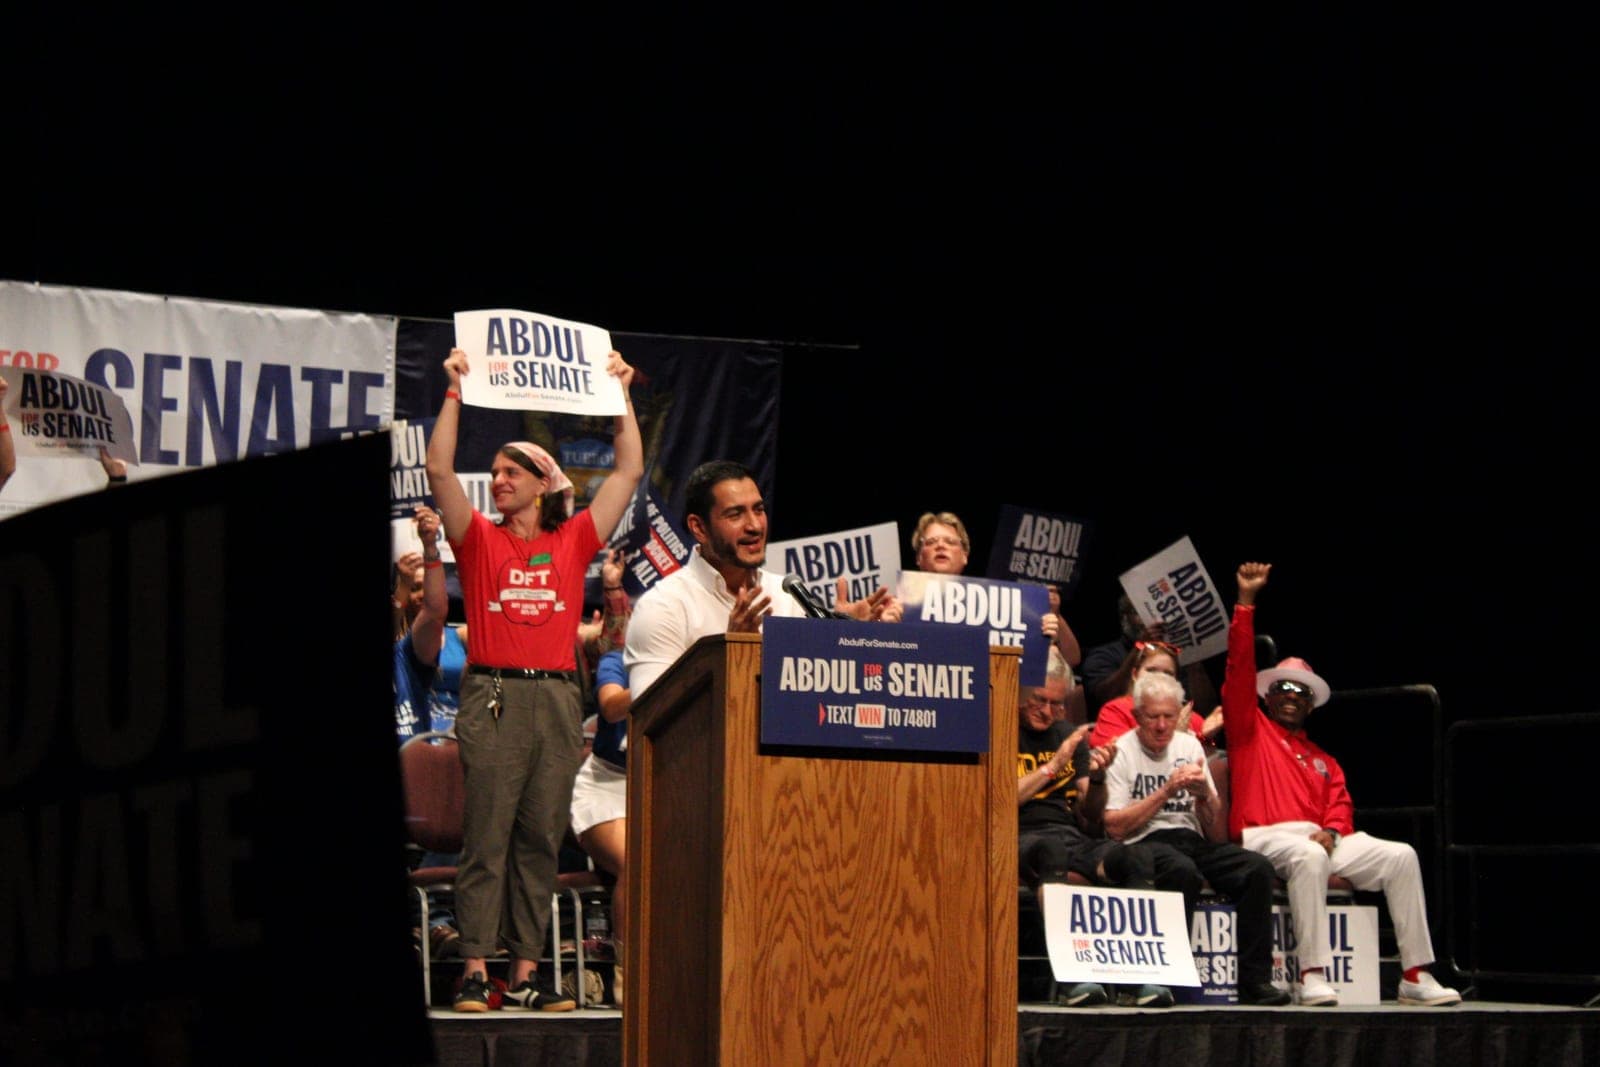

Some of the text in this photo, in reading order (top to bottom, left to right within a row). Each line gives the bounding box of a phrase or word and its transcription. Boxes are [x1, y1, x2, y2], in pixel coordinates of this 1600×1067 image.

[486, 317, 592, 367] ABDUL
[488, 361, 509, 372] FOR
[489, 360, 595, 395] US SENATE
[20, 373, 114, 422] ABDUL
[84, 347, 385, 466] SENATE
[43, 412, 116, 444] SENATE
[651, 515, 689, 561] POLITICS
[1014, 513, 1083, 558] ABDUL
[509, 568, 551, 587] DFT
[785, 535, 880, 583] ABDUL
[921, 580, 1028, 631] ABDUL
[1168, 562, 1226, 647] ABDUL
[838, 637, 919, 650] AbdulForSenate.com
[780, 656, 861, 695] ABDUL
[863, 663, 883, 676] FOR
[863, 661, 975, 700] US SENATE
[826, 704, 937, 729] TEXT WIN TO 74801
[1070, 893, 1165, 937] ABDUL
[1072, 939, 1090, 949] FOR
[1075, 938, 1171, 967] US SENATE
